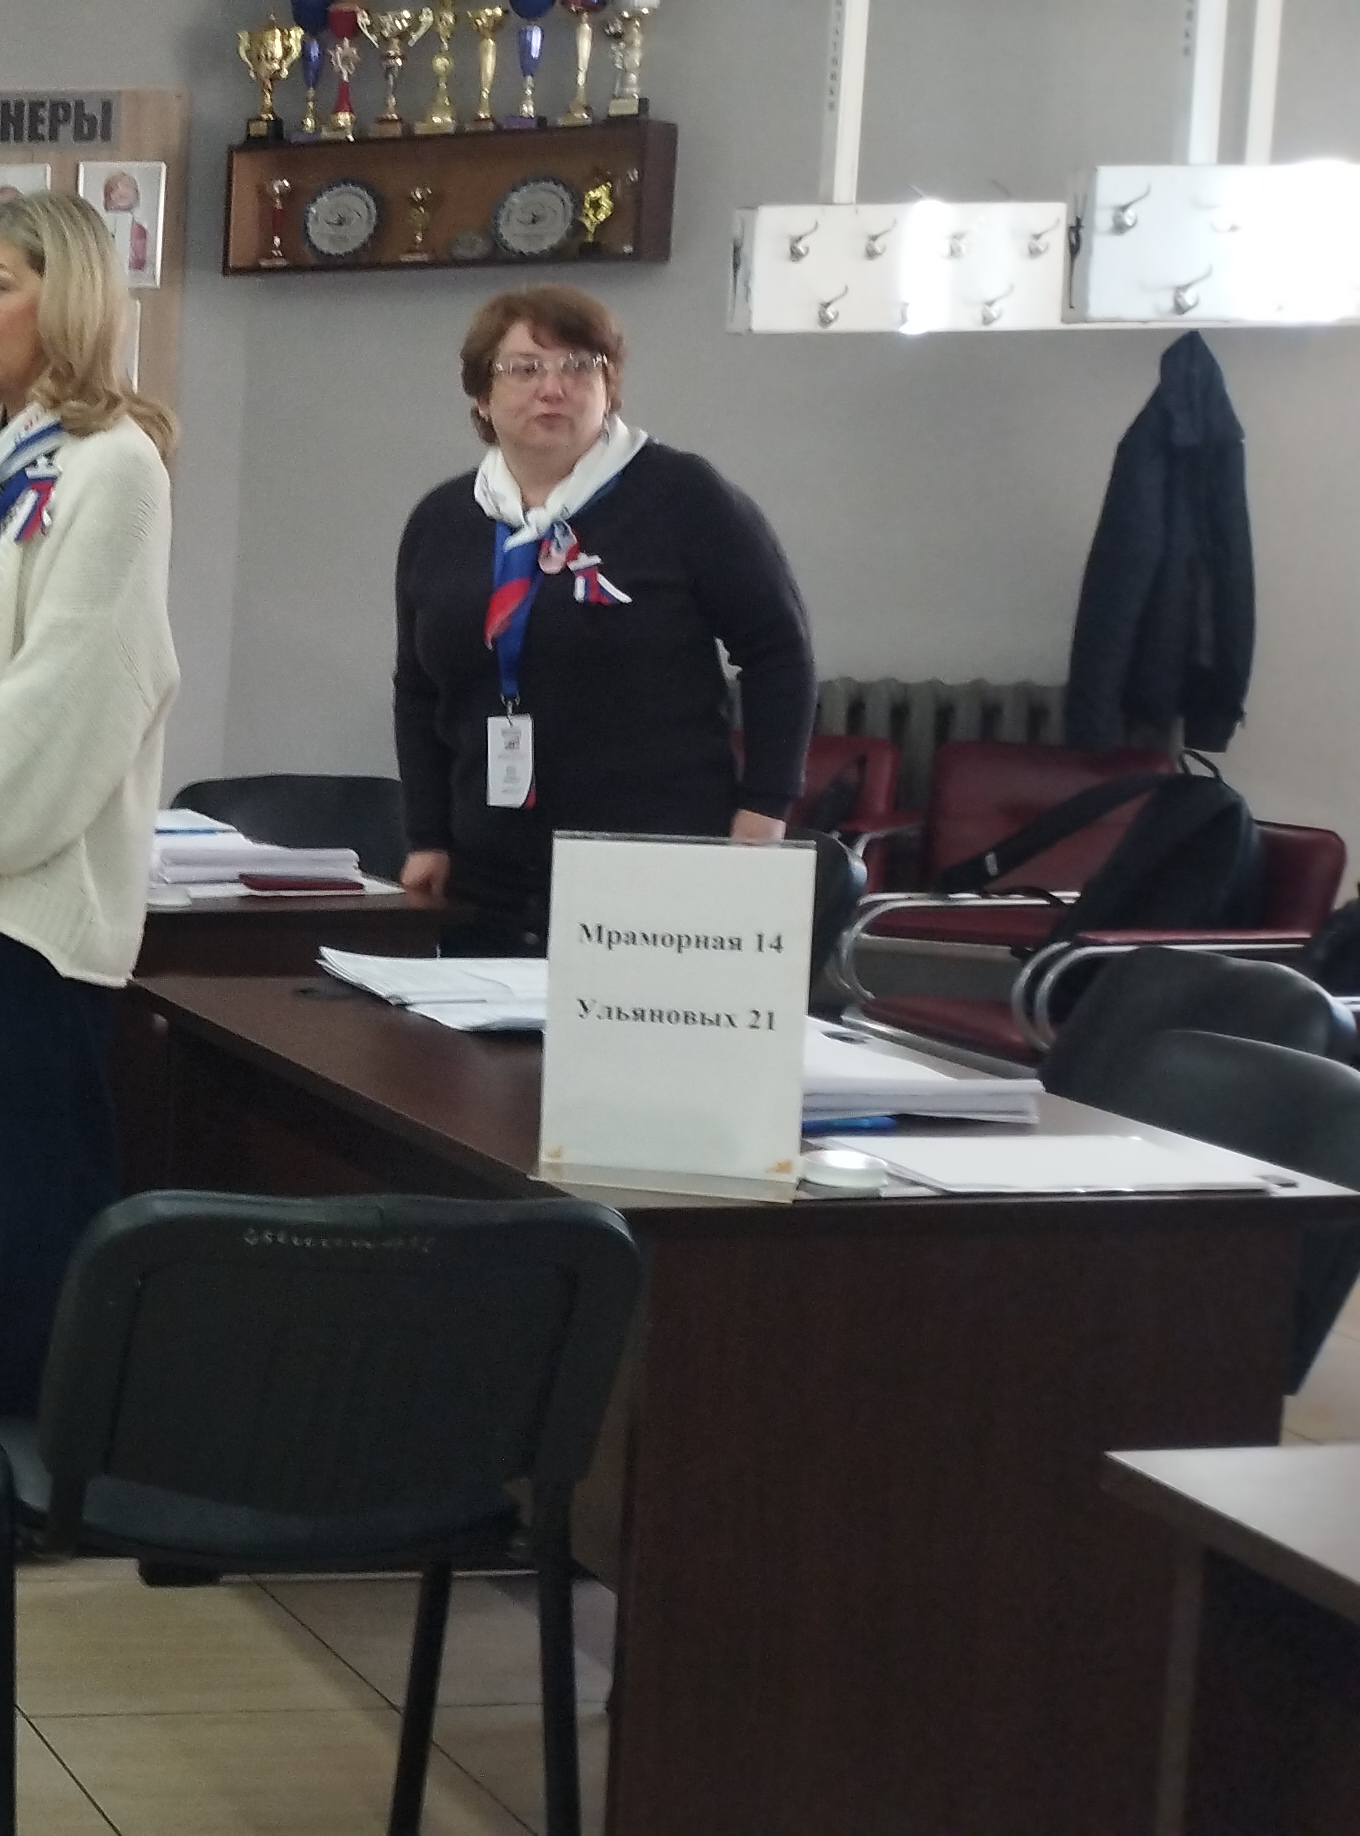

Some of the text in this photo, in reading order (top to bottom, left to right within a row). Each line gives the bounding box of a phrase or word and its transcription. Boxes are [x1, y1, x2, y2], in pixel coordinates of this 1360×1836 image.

[578, 922, 784, 953] Мраморная 14
[576, 997, 776, 1031] Ульяновых 21
